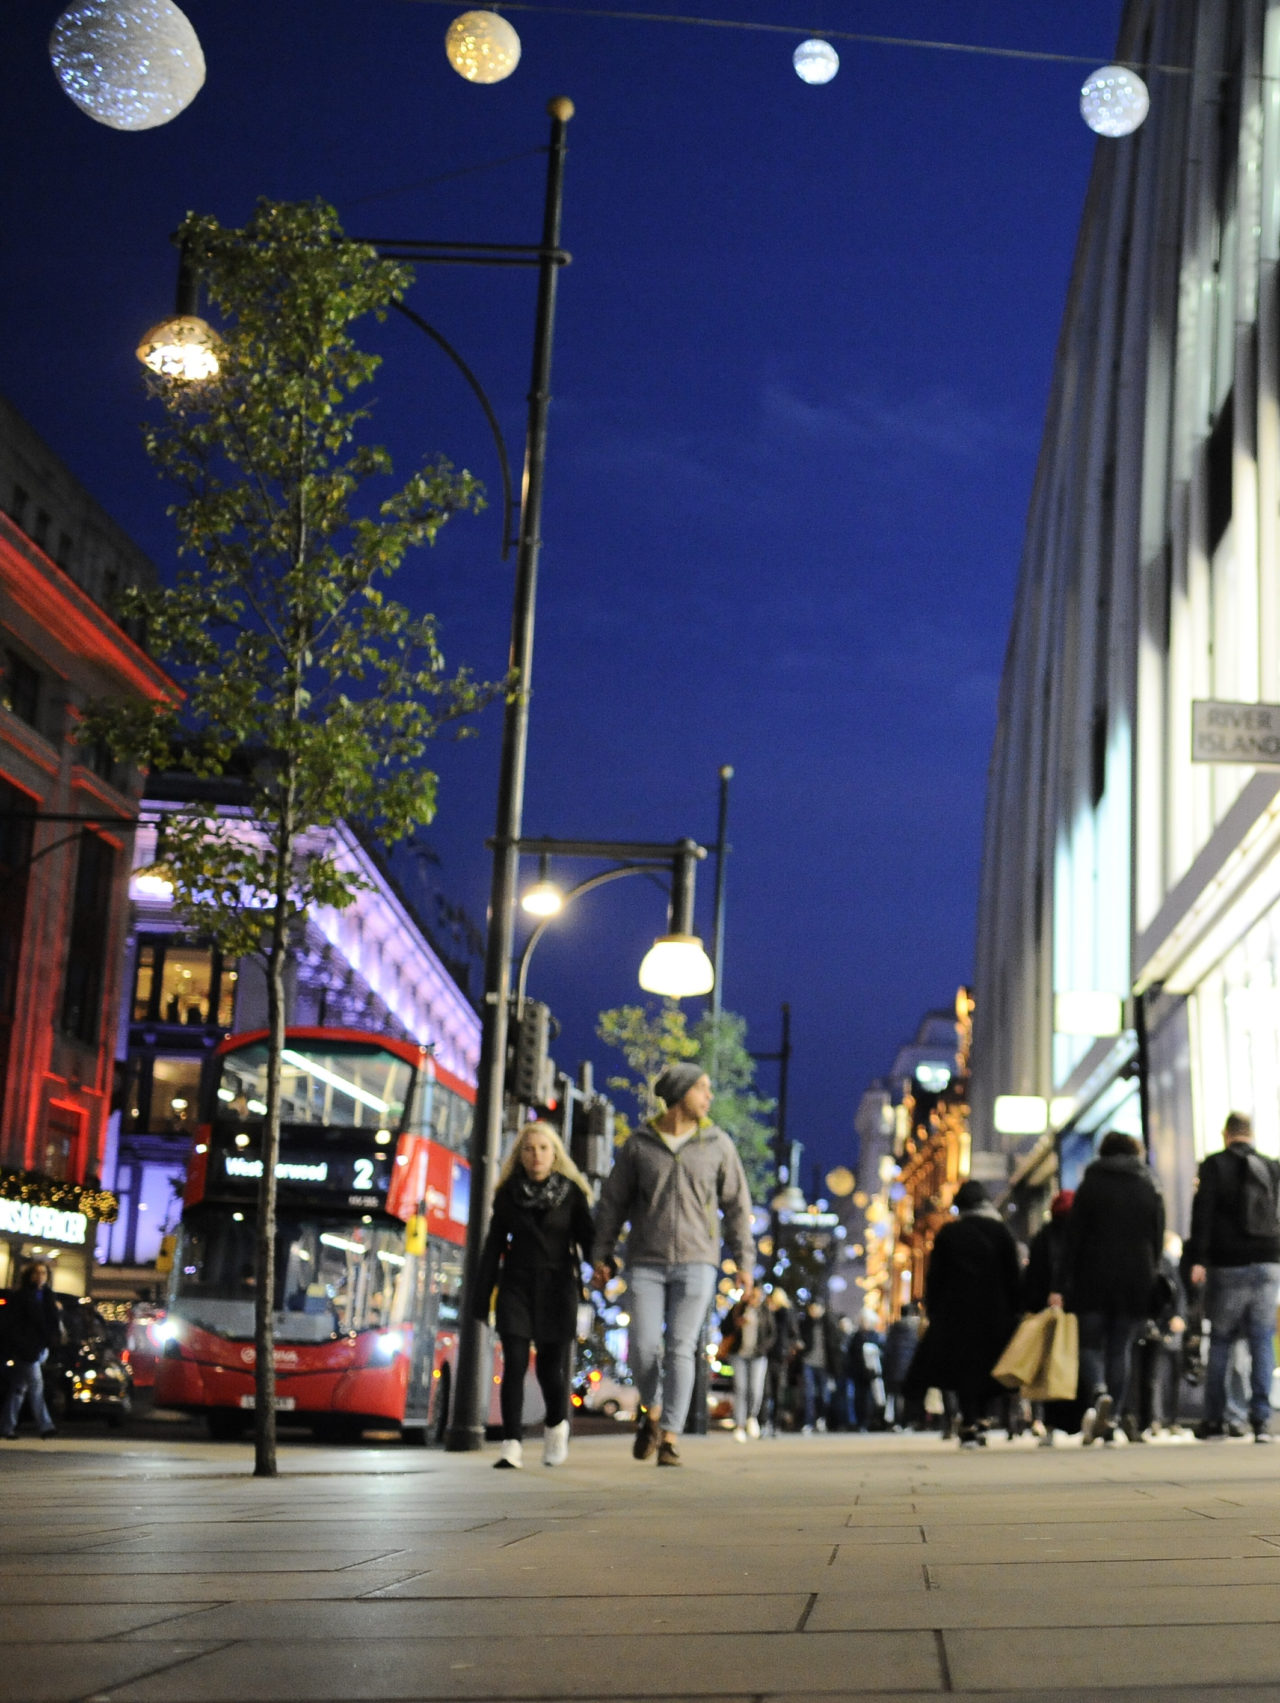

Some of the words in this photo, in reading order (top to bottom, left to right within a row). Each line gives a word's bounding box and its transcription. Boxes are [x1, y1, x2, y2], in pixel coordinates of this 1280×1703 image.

[1207, 708, 1272, 729] RIVER
[272, 1162, 329, 1182] orwood
[352, 1158, 375, 1190] 2
